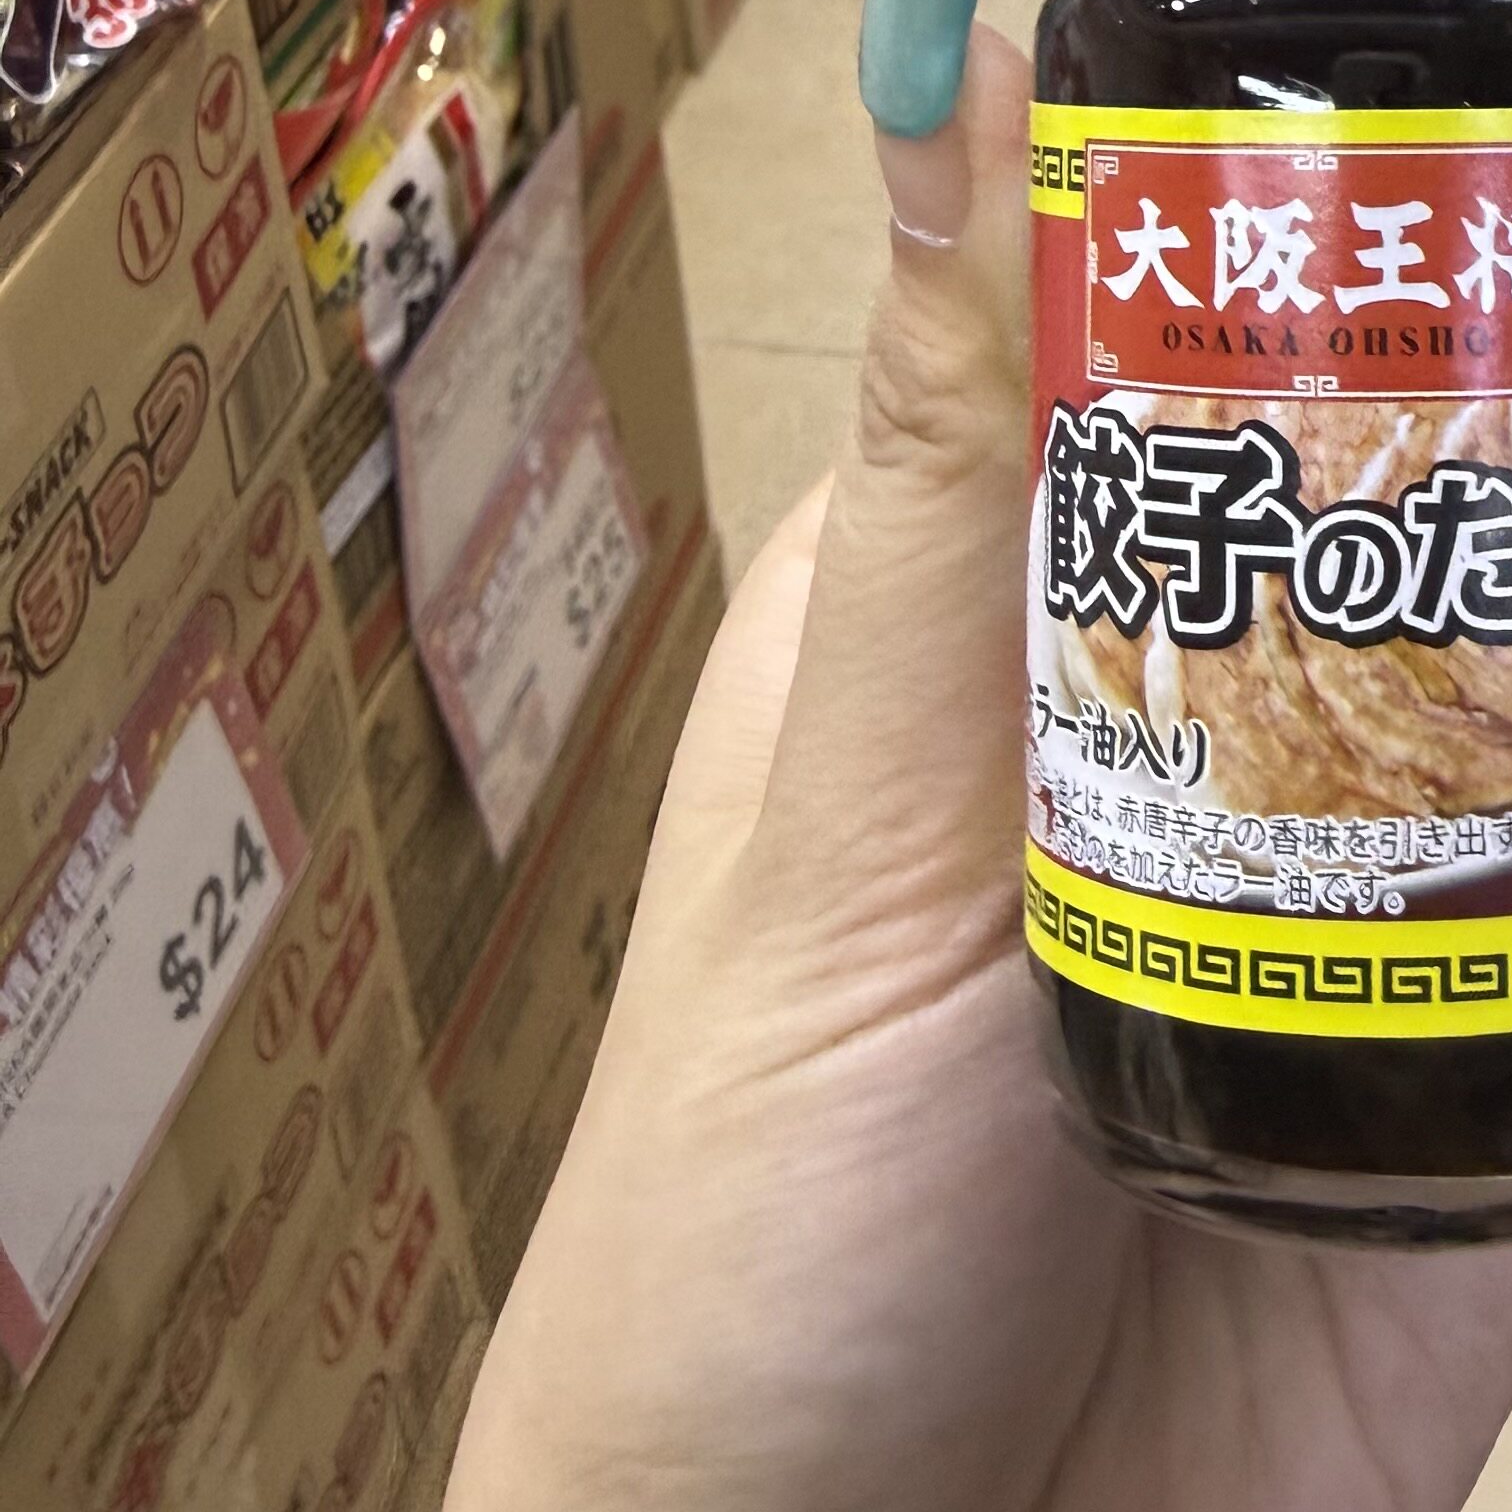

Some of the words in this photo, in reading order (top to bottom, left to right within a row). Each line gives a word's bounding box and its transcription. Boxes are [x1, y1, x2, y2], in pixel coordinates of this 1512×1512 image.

[1161, 321, 1301, 358] OSAKA
[1328, 326, 1490, 358] OHSHO
[1036, 683, 1206, 788] ラー油入り
[160, 816, 267, 1022] $24
